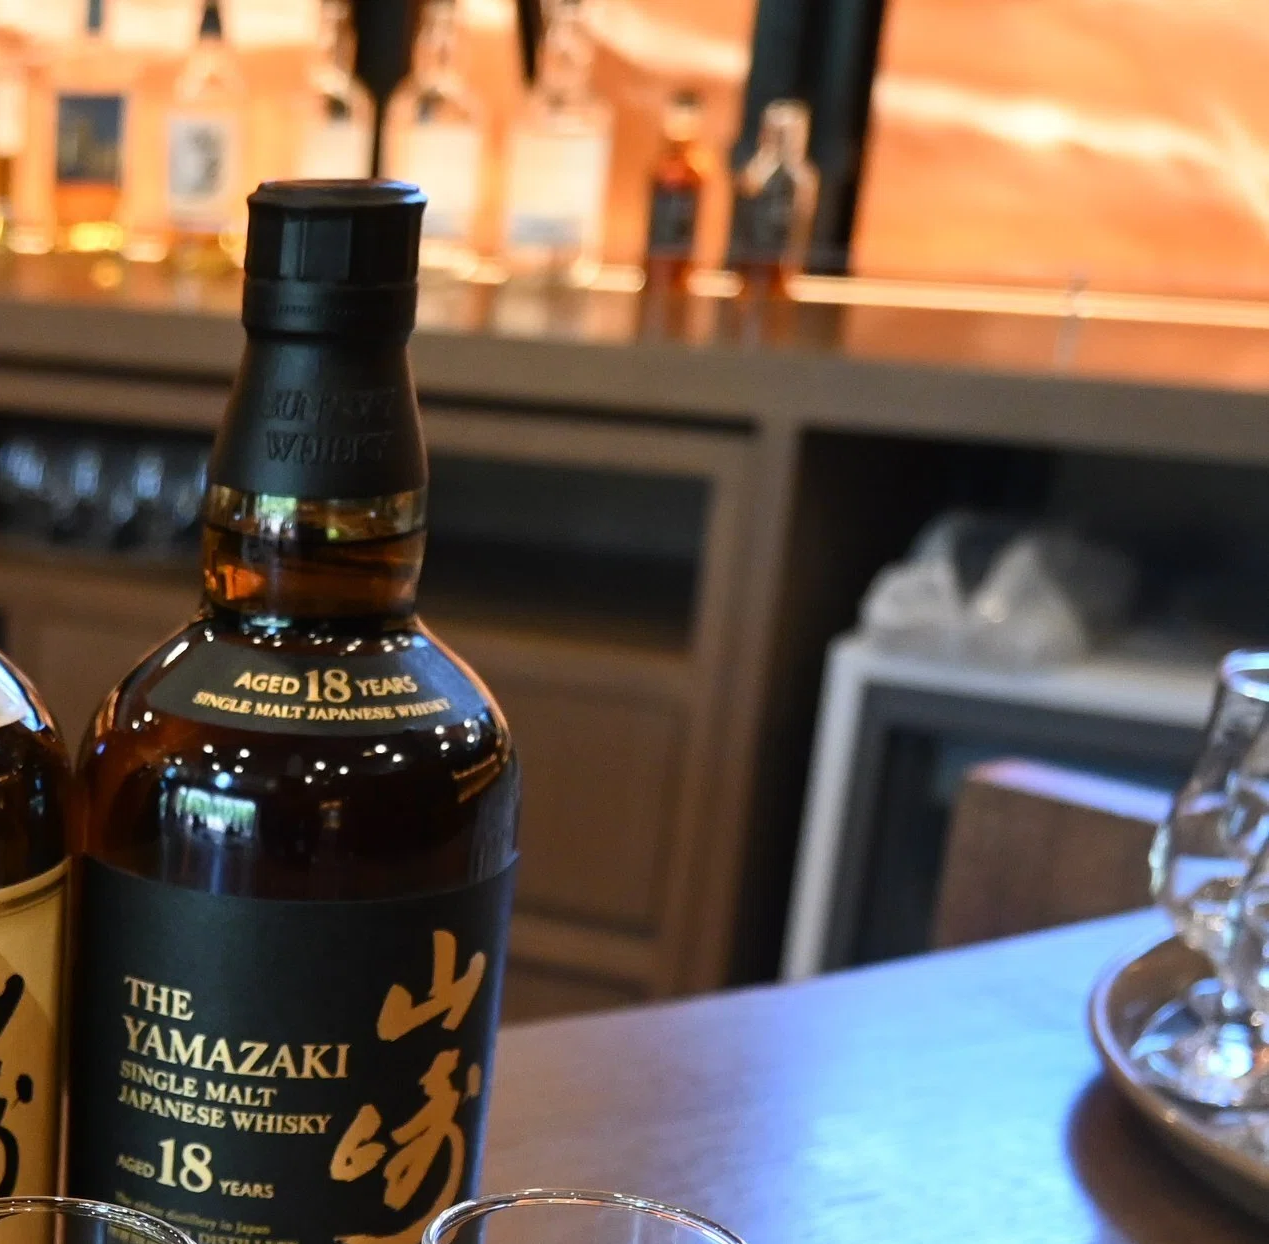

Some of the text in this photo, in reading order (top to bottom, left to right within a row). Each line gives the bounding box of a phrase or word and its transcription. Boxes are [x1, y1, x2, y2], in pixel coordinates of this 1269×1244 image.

[192, 690, 451, 721] SINGLE MALT JAPANESE WHISKY
[234, 669, 418, 703] AGED 18 YEARS
[123, 976, 194, 1021] THE
[122, 1015, 351, 1079] YAMAZAKI
[120, 1060, 277, 1108] SINGLE MALT
[118, 1085, 331, 1135] JAPANESE WHISKY
[116, 1138, 275, 1199] AGED 18 YEARS
